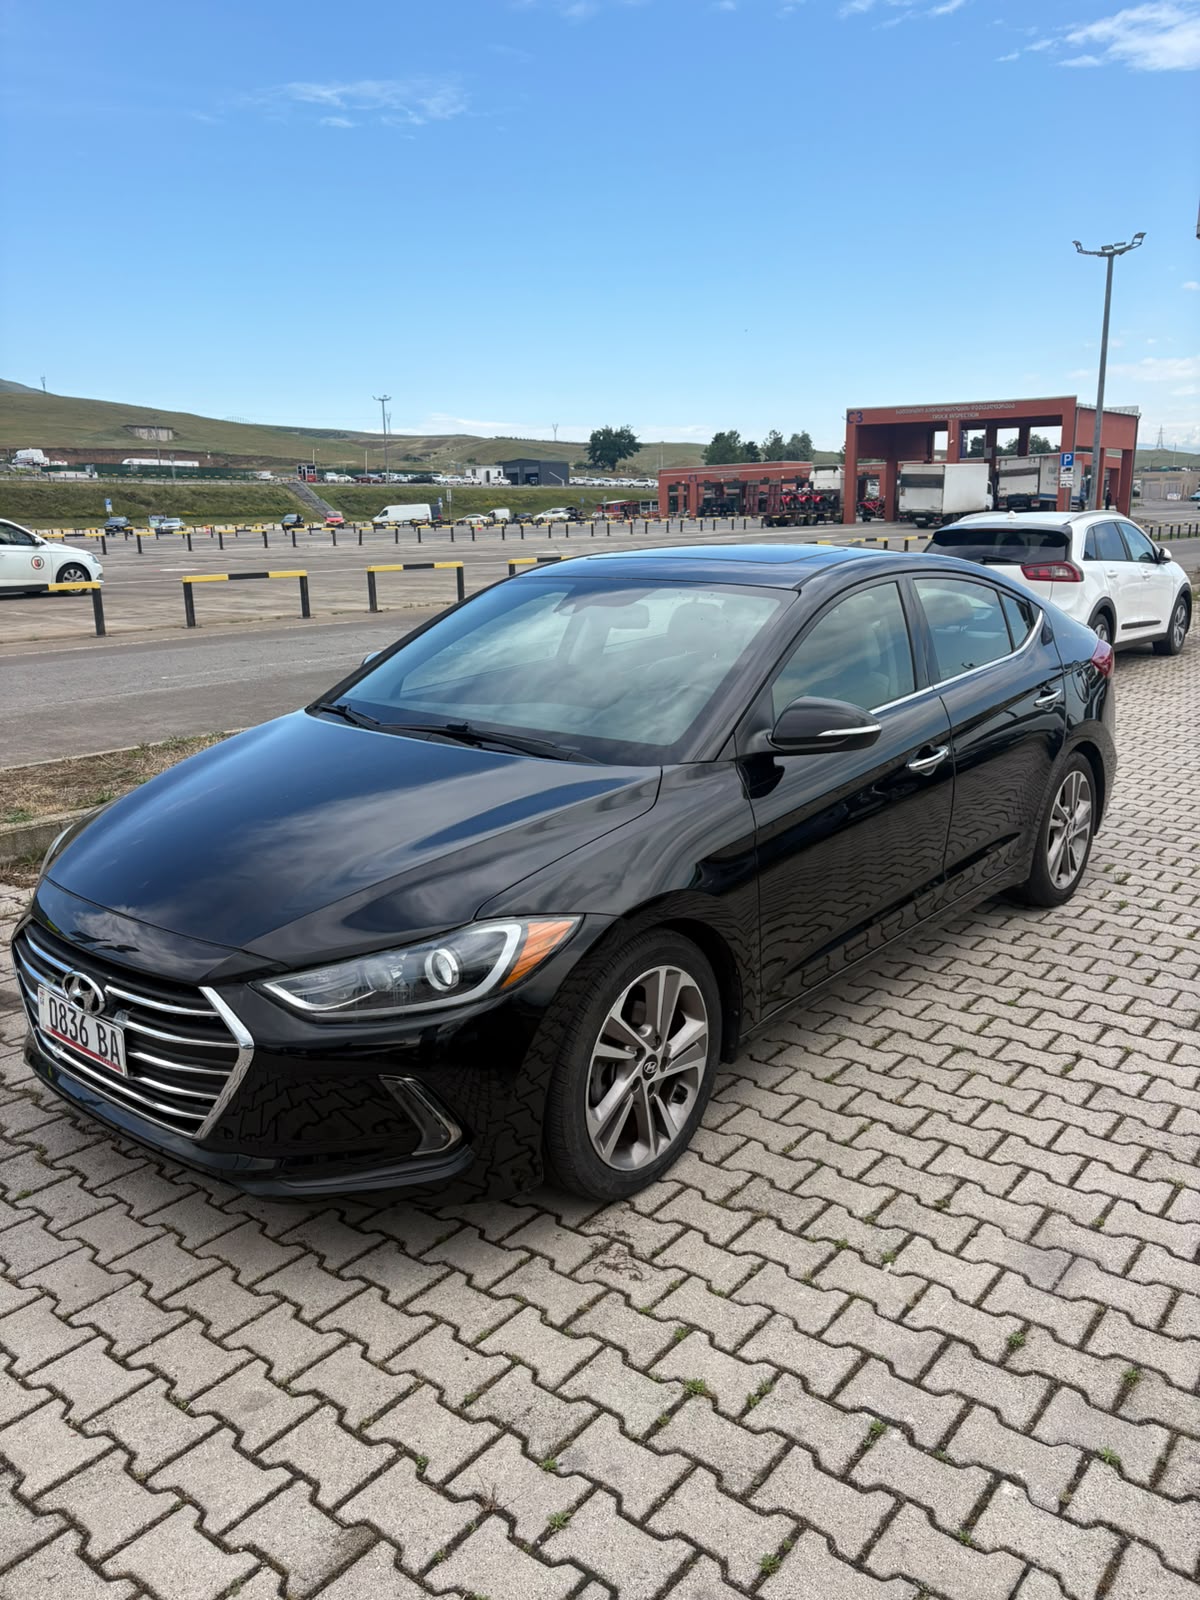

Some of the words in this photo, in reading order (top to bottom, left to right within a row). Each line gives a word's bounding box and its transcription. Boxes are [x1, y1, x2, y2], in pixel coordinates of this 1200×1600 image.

[846, 411, 863, 424] C3
[1064, 454, 1072, 465] P
[49, 996, 88, 1047] 0836
[96, 1022, 120, 1066] BA
